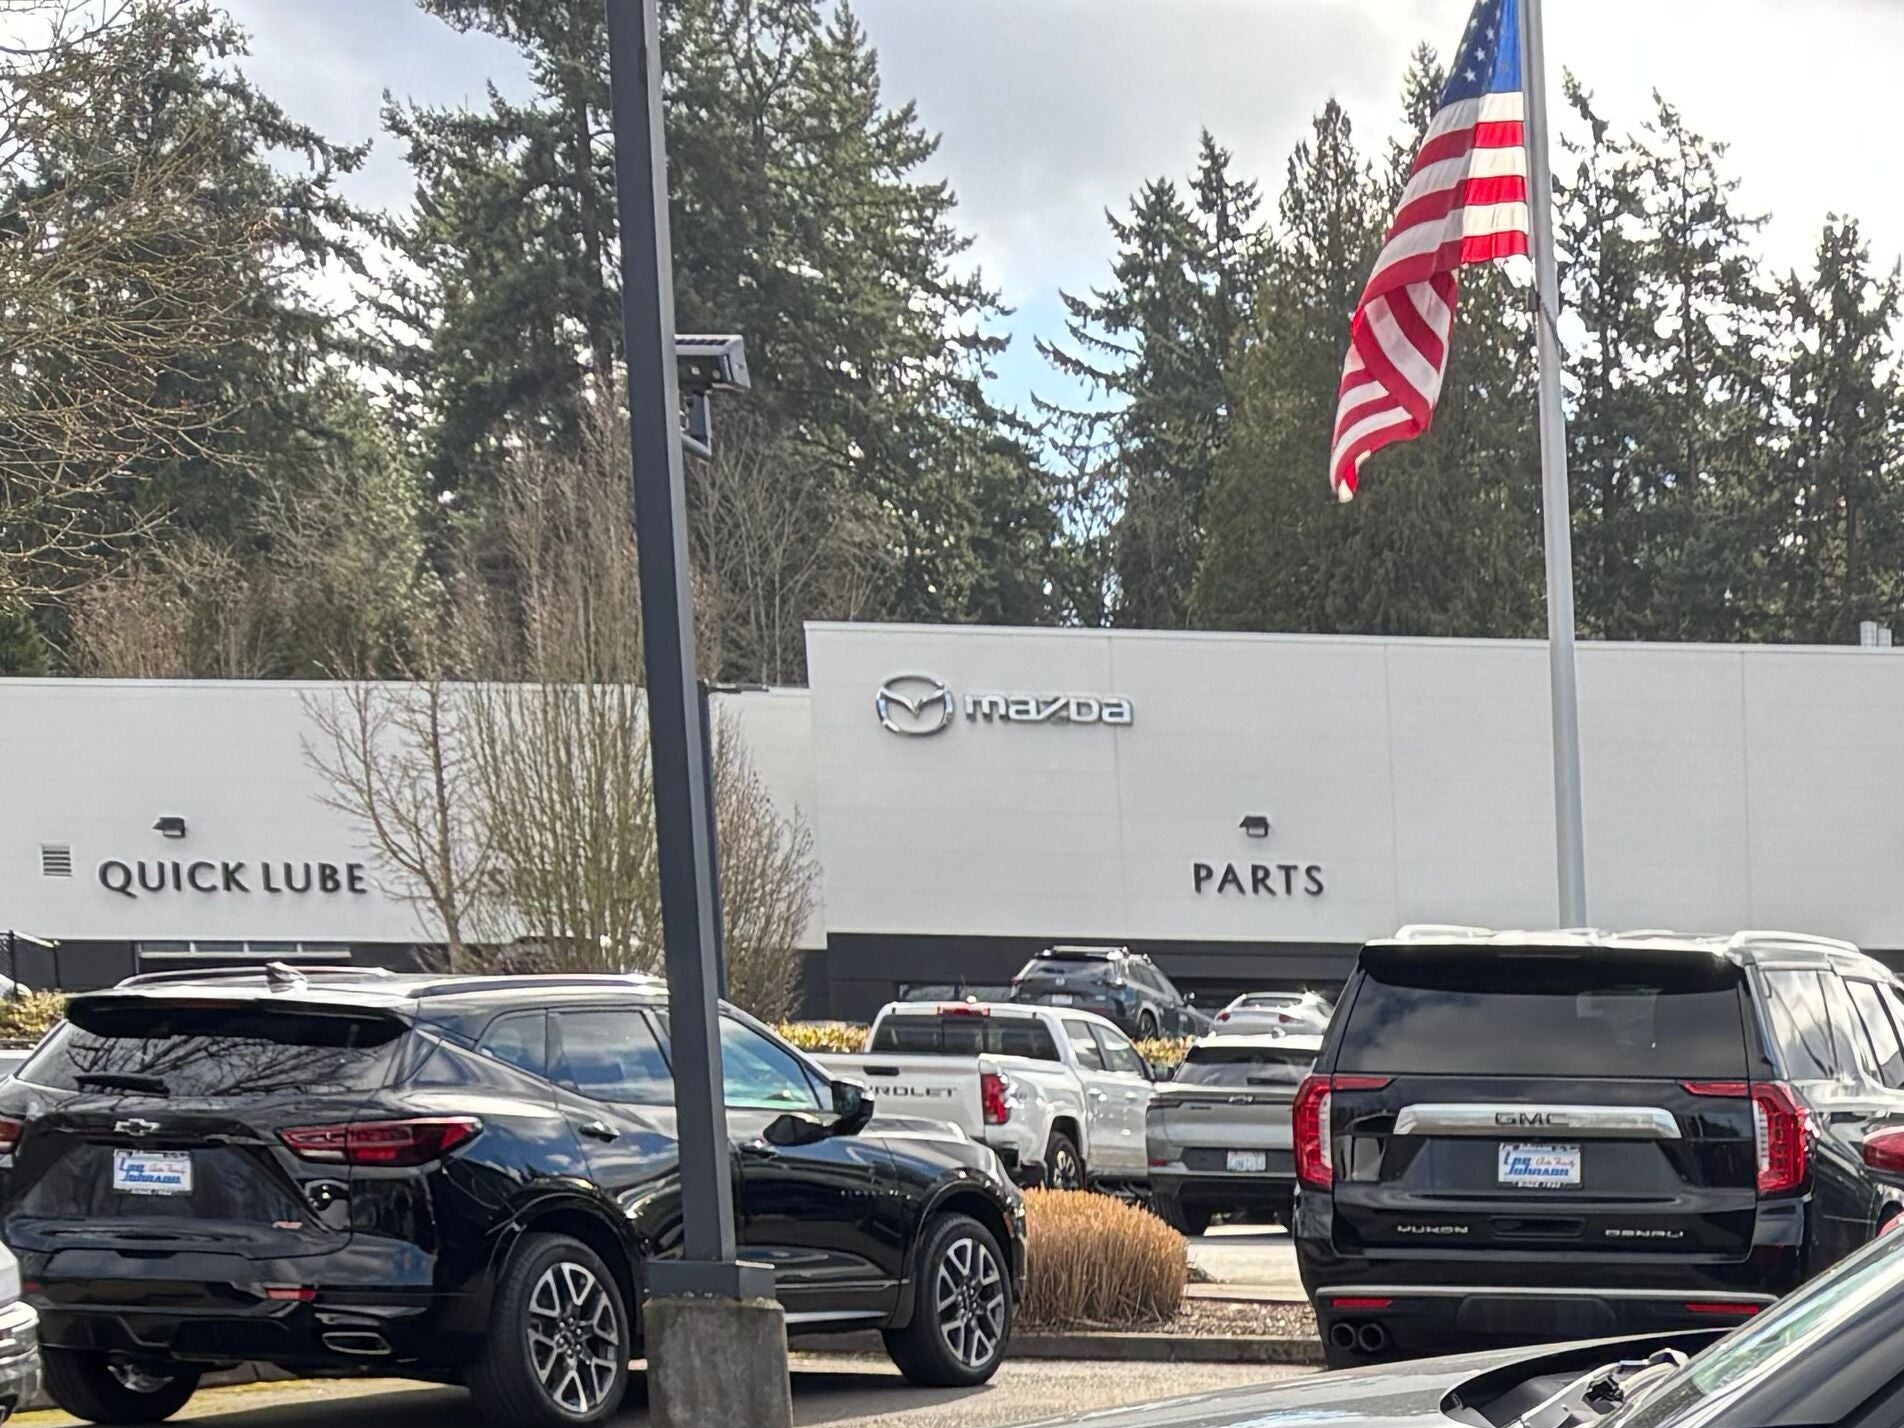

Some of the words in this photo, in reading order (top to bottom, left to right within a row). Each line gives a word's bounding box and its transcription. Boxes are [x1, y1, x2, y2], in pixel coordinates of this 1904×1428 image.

[99, 860, 250, 899] QUICK
[260, 861, 368, 894] LUBE
[1193, 862, 1324, 896] PARTS
[1495, 1112, 1568, 1126] GMC
